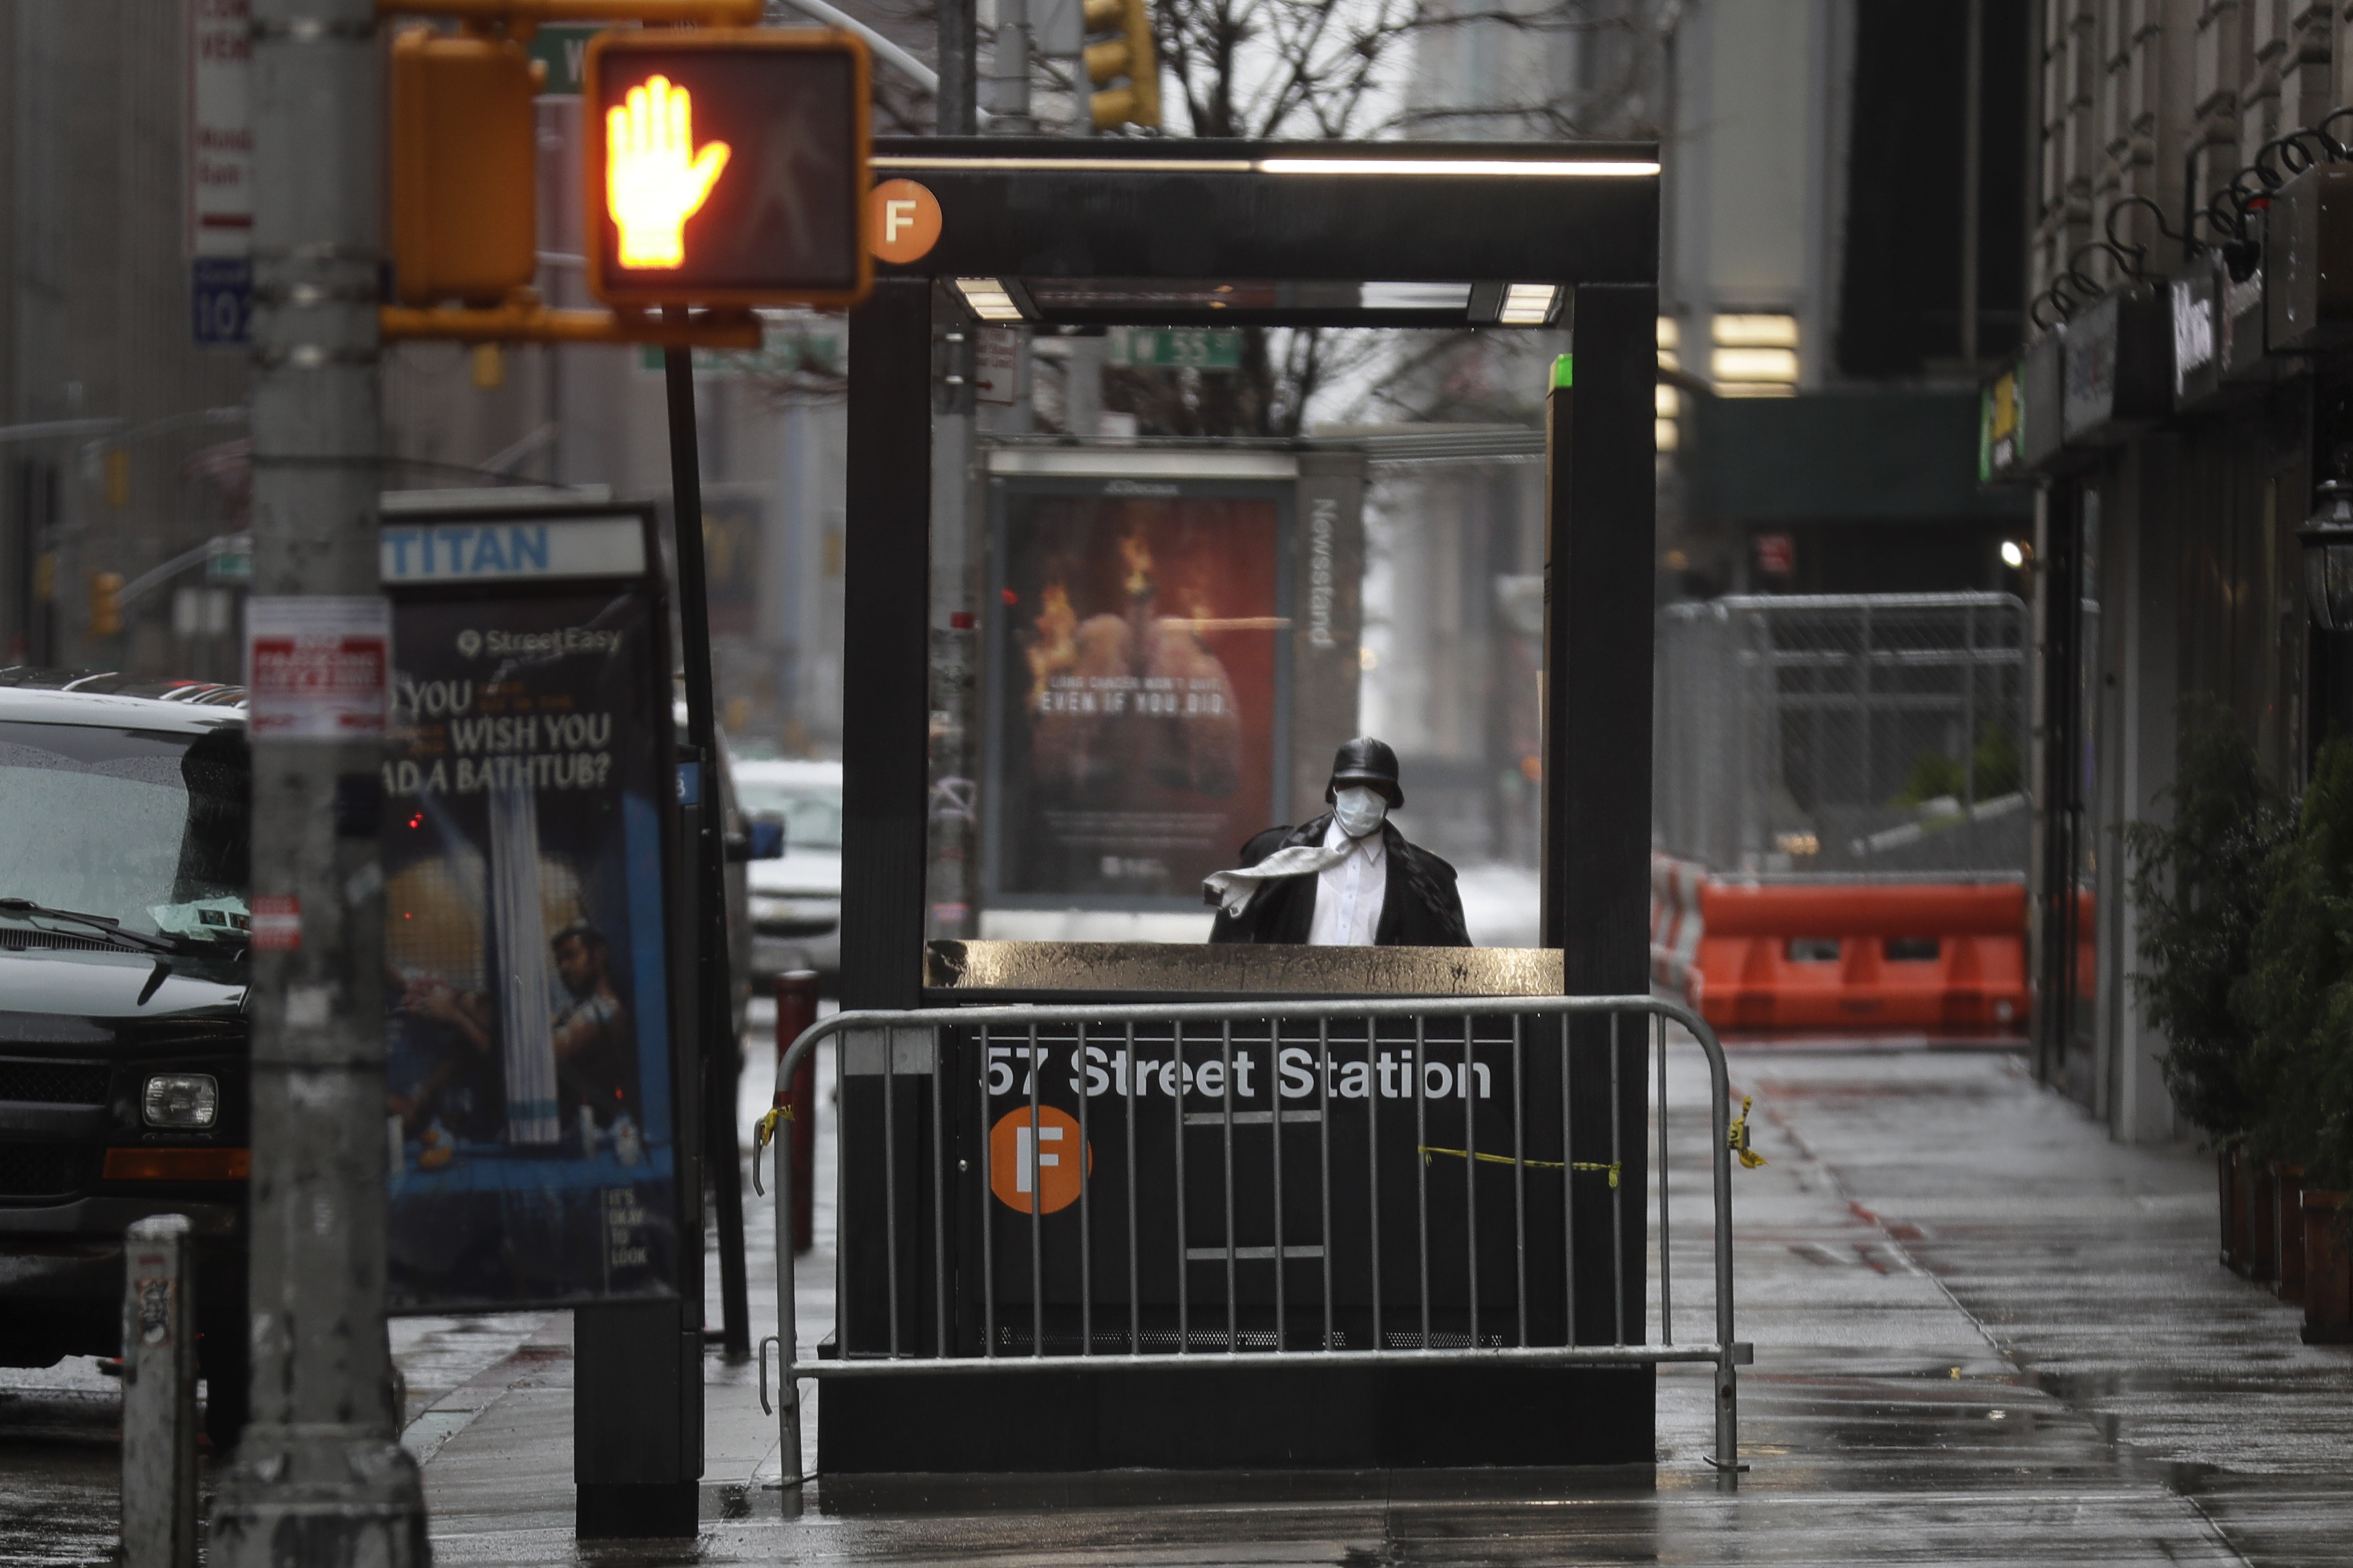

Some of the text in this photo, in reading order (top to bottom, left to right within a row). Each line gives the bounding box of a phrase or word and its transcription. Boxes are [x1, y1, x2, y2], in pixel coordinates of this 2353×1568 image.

[886, 199, 917, 243] F
[381, 526, 549, 574] TITAN
[1310, 498, 1338, 649] Newsstand
[486, 627, 624, 658] StreetEasy
[404, 677, 472, 721] YOU
[1040, 691, 1095, 713] EVEN
[1104, 692, 1125, 713] IF
[1135, 692, 1178, 713] YOU
[450, 715, 539, 754] WISH
[543, 712, 612, 750] YOU
[426, 758, 448, 794] A
[456, 751, 612, 794] BATHTUB?
[979, 1046, 1491, 1098] 57 Street Station
[1016, 1126, 1063, 1192] F
[612, 1246, 648, 1266] LOOK
